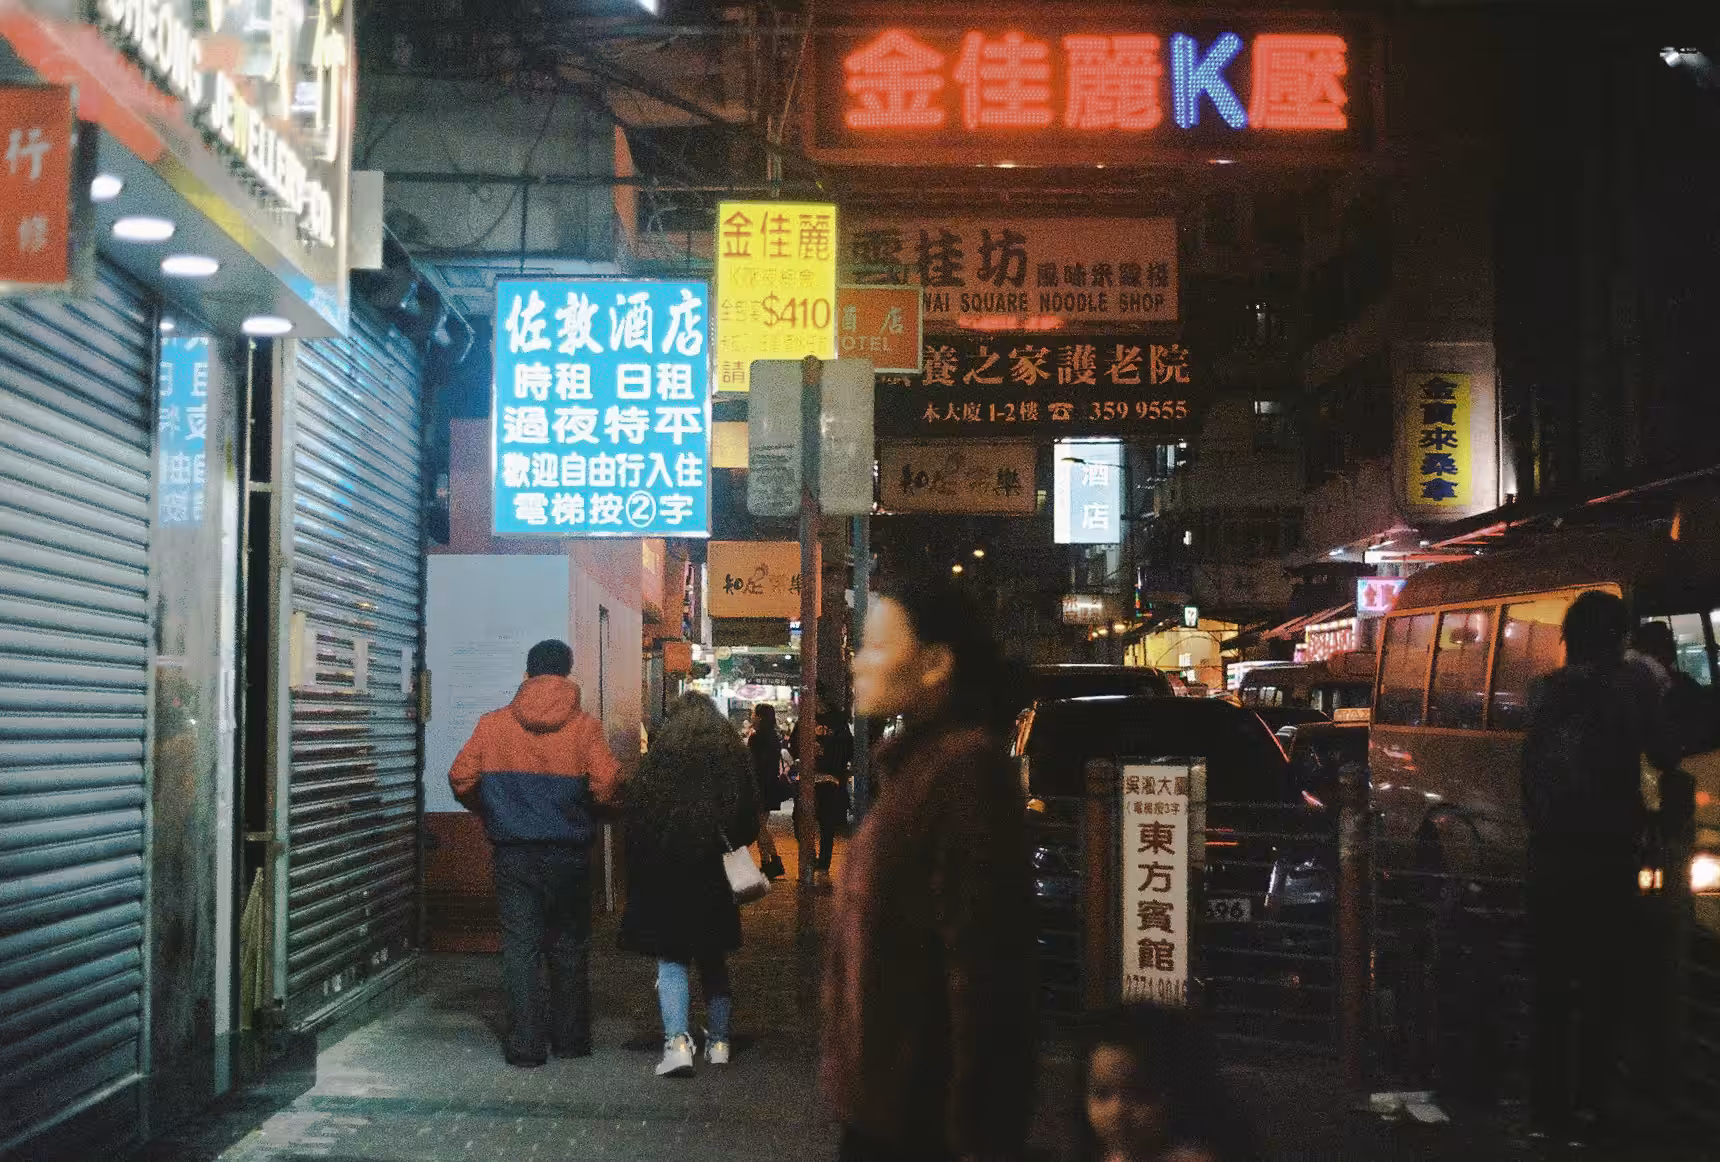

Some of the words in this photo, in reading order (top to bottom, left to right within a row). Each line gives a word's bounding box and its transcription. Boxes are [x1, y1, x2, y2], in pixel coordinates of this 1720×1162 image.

[723, 211, 831, 261] 金佳麗
[505, 290, 704, 356] 佐敦酒店
[761, 290, 831, 329] $410
[960, 293, 1029, 314] SQUARE
[1040, 293, 1107, 313] NOODLE
[1119, 293, 1165, 313] SHOP
[841, 335, 891, 351] OTEL
[514, 362, 593, 401] 時租
[616, 362, 695, 401] 日租
[880, 343, 1191, 387] 養之家護老院
[503, 405, 703, 445] 過夜特平
[1089, 402, 1129, 421] 359
[1135, 400, 1187, 421] 9555
[503, 452, 703, 488] 歡迎自由行入住
[1137, 820, 1176, 972] 東方賓館
